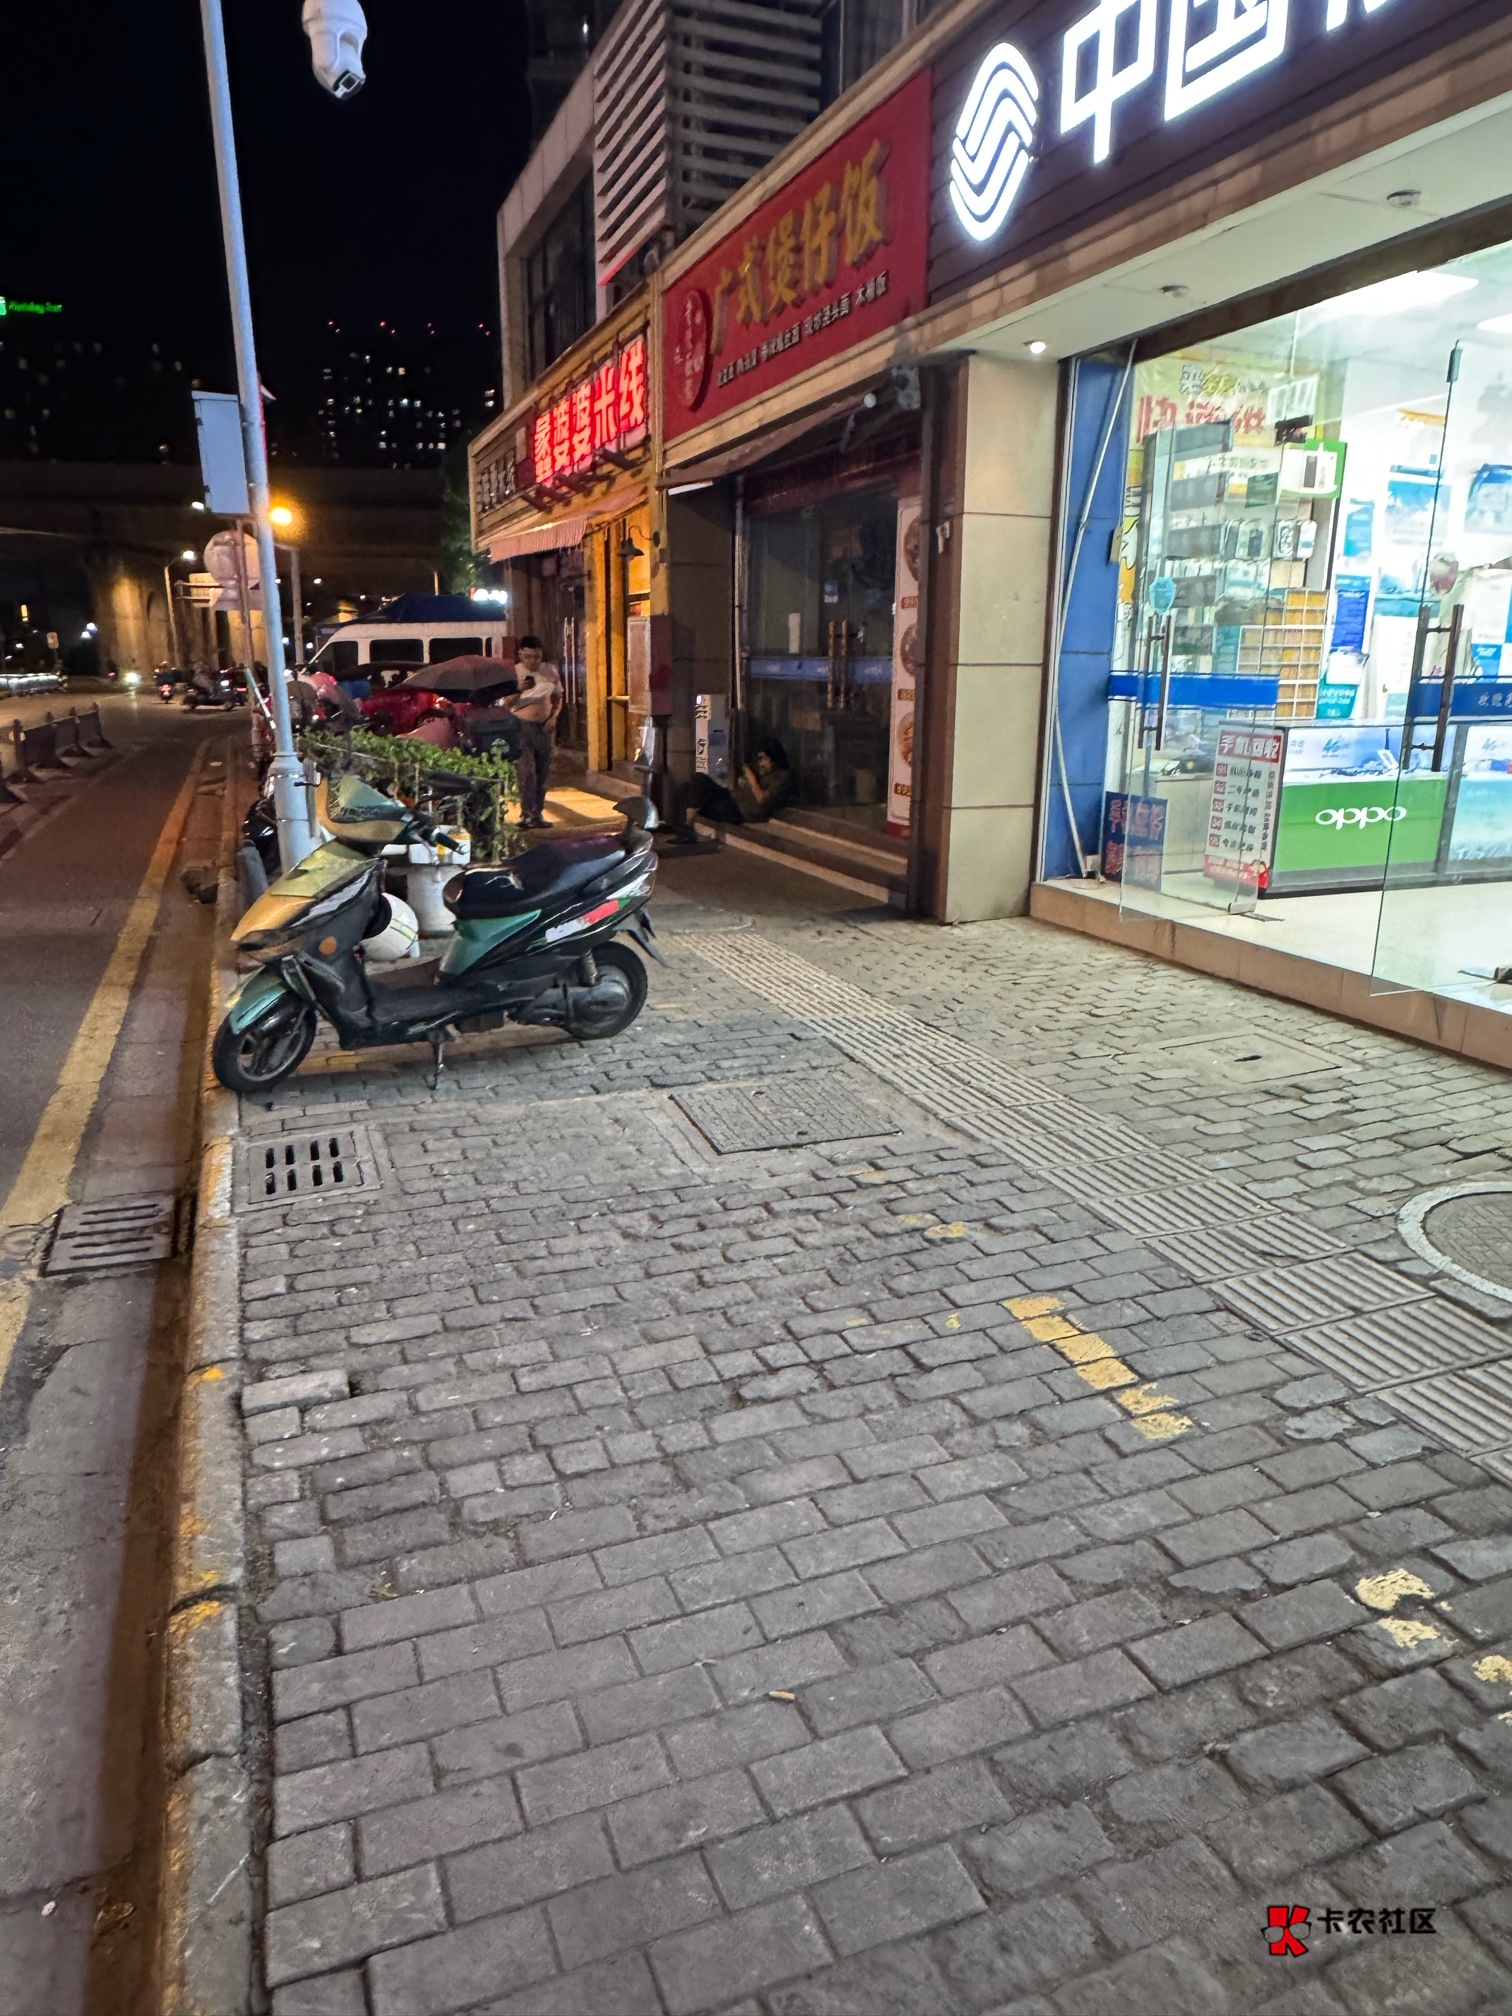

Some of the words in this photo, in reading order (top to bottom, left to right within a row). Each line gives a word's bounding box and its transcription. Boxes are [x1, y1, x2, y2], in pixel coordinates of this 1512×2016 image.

[1059, 0, 1400, 165] 中国
[711, 138, 887, 353] 广式煲仔饭
